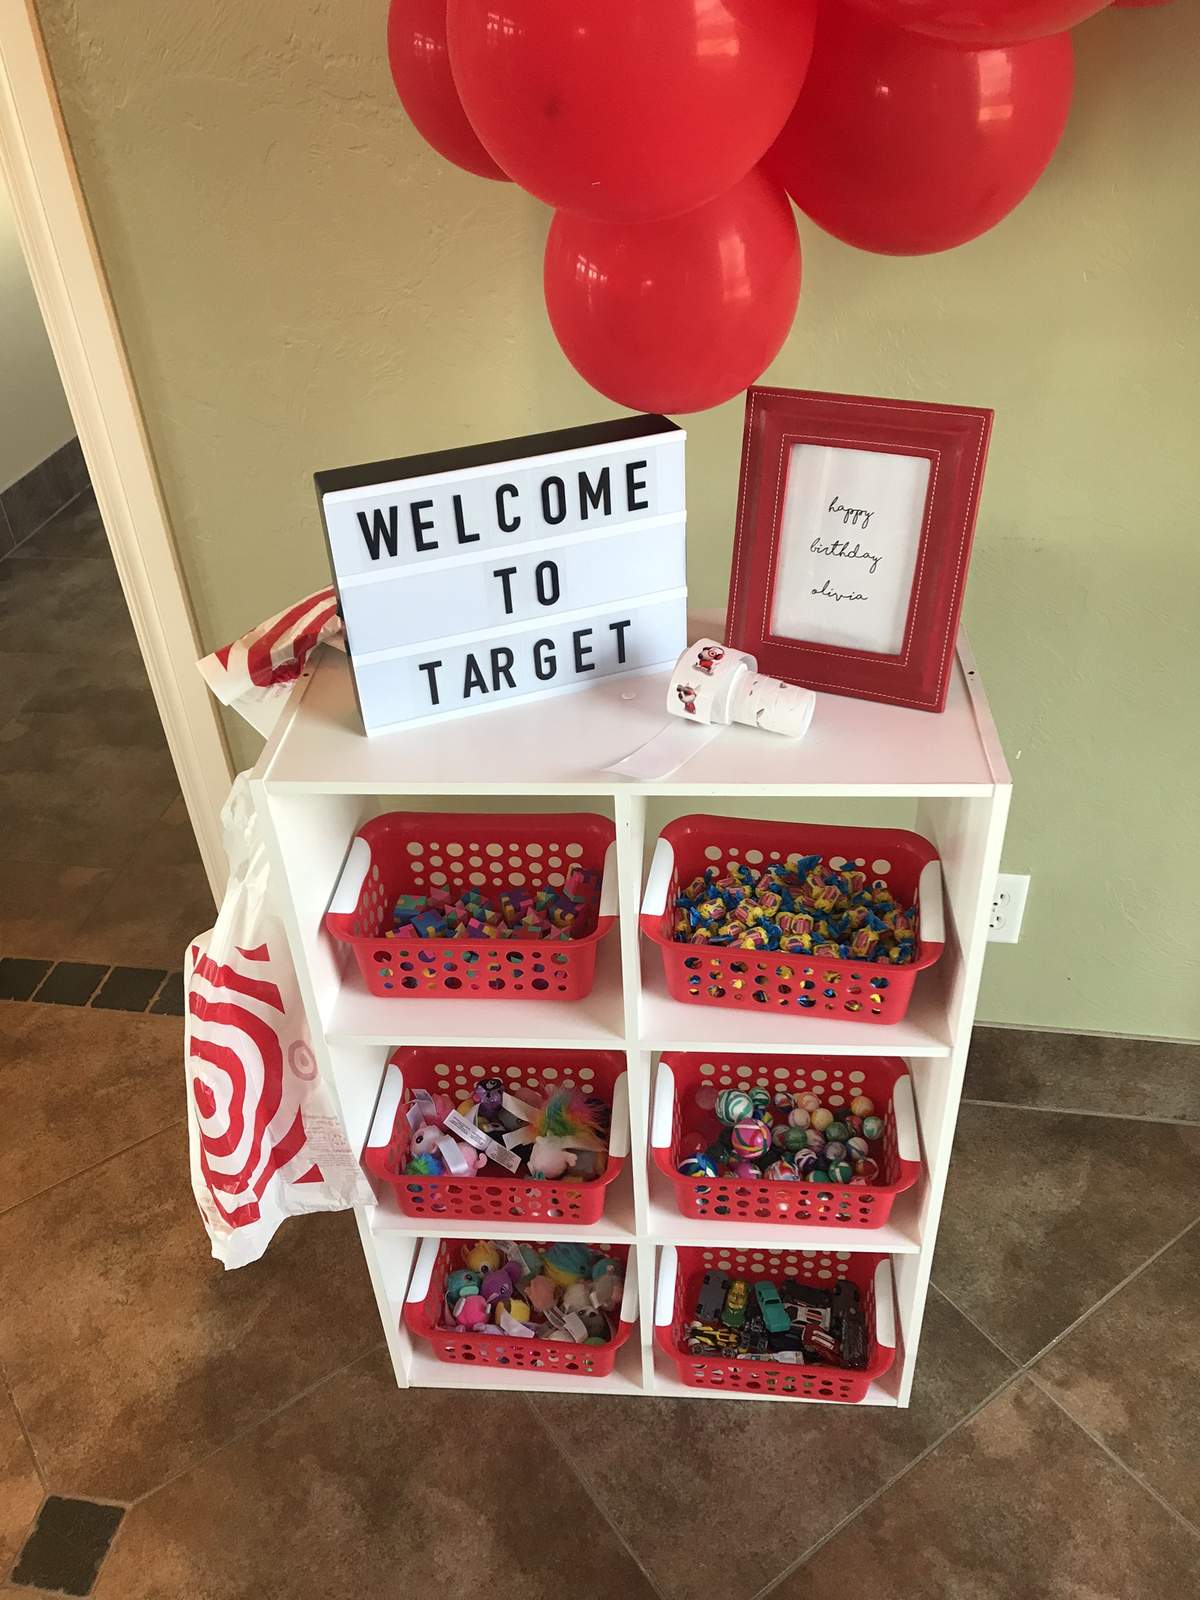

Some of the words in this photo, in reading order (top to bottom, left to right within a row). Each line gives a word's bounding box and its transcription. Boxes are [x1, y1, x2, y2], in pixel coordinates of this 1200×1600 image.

[357, 460, 649, 561] WELCOME
[828, 496, 875, 529] happy
[809, 537, 883, 574] birthday
[493, 560, 560, 614] TO
[811, 580, 869, 601] olivia
[419, 620, 631, 705] TARGET
